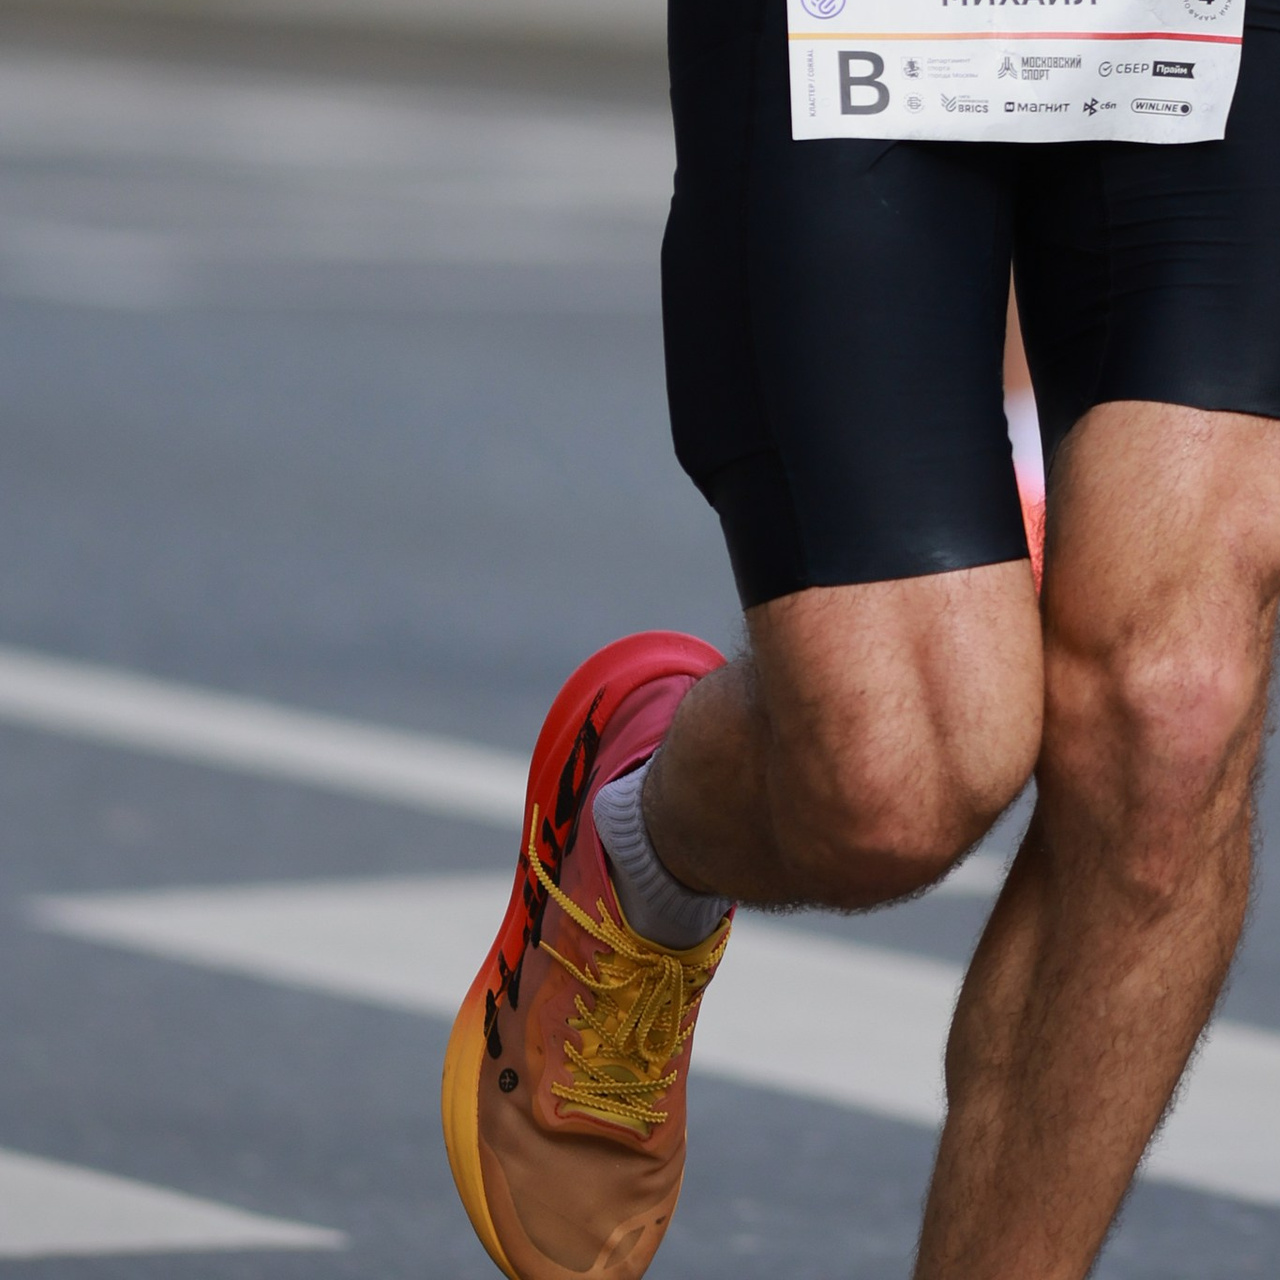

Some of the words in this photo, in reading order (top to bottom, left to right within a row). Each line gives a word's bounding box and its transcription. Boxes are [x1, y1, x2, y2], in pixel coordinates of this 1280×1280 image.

[1021, 55, 1082, 69] МОСКОВСКИЙ
[1115, 63, 1150, 74] СБЕР
[1156, 64, 1188, 75] Прайм
[1021, 70, 1050, 81] СПОРТ
[958, 104, 989, 113] BRICS
[1017, 101, 1070, 113] магнит
[1135, 101, 1179, 113] WINLINE
